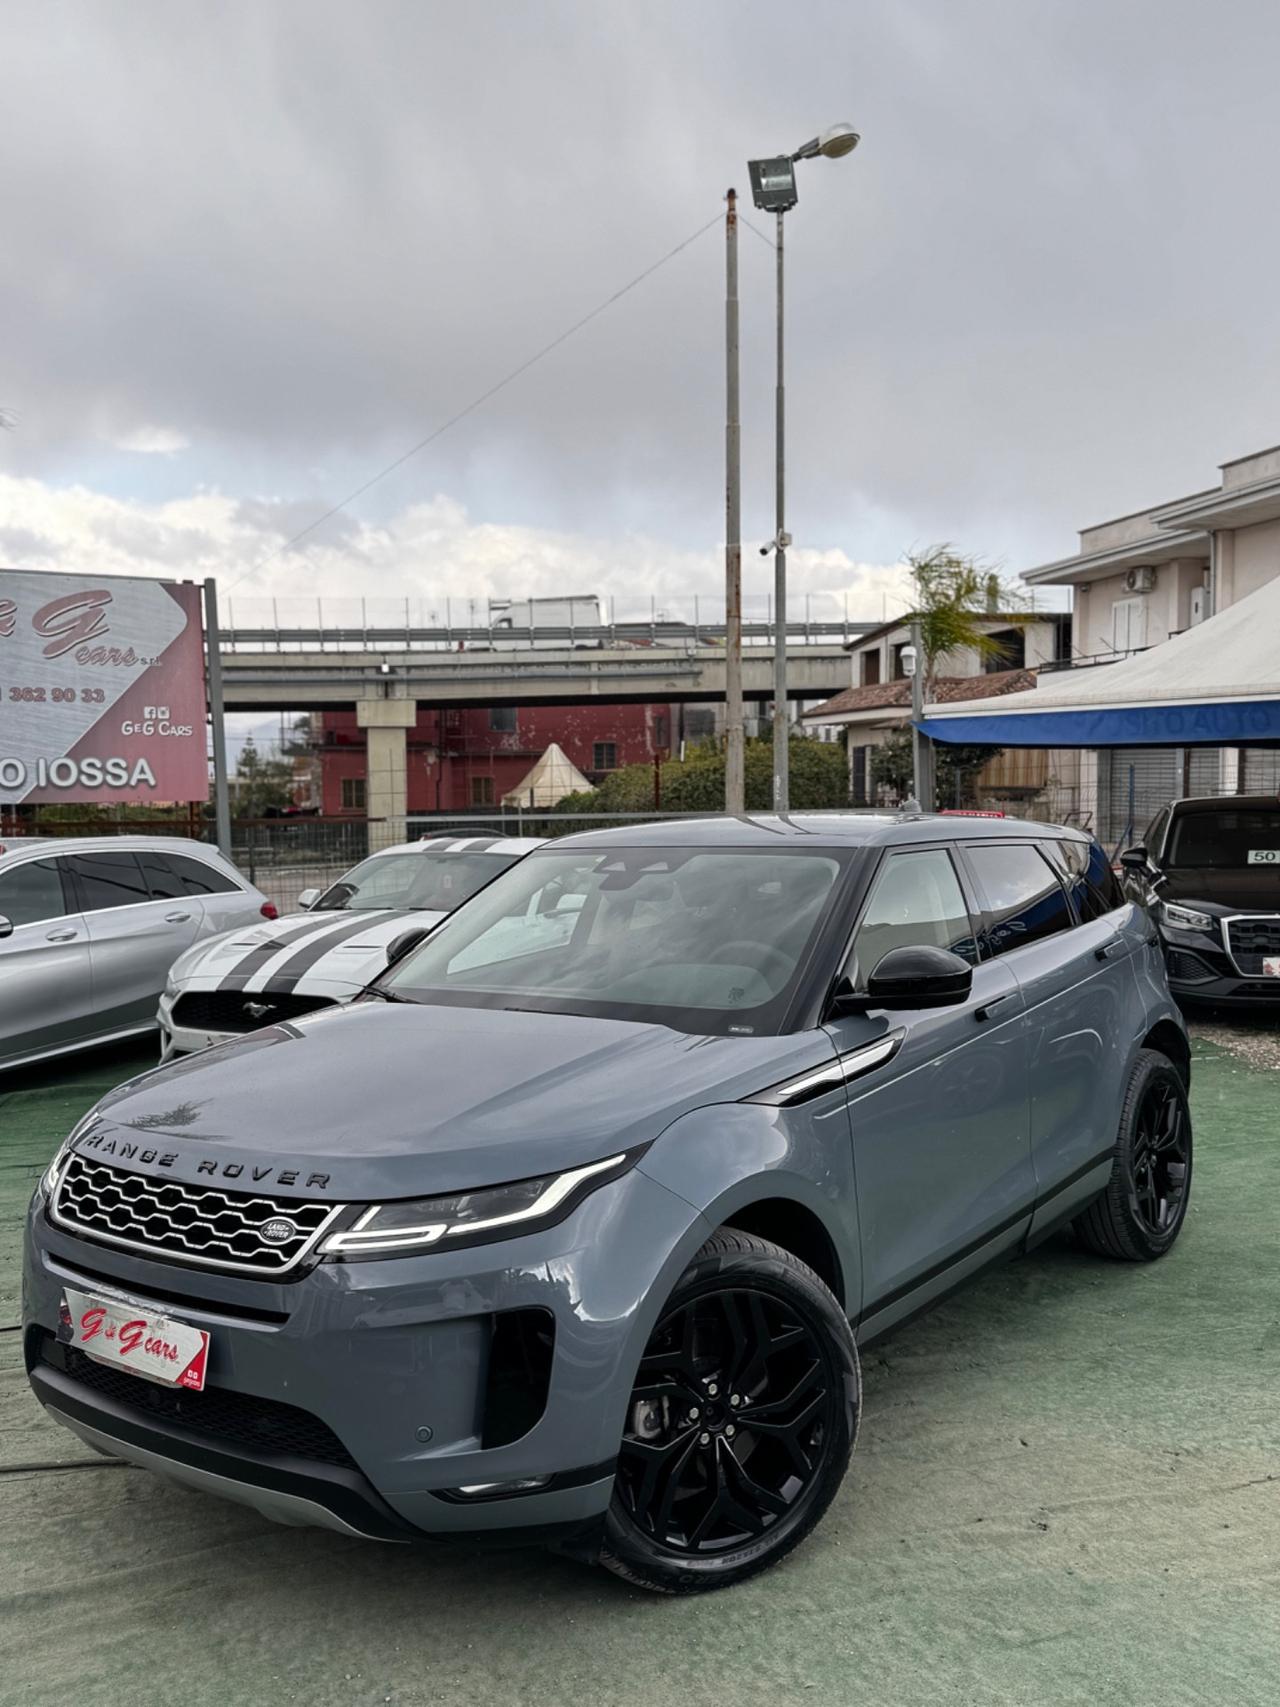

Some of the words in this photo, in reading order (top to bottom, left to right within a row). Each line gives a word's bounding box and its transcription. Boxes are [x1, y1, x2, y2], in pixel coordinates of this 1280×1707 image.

[9, 686, 47, 702] 362
[51, 687, 76, 703] 90
[81, 687, 105, 703] 33
[38, 757, 156, 788] IOSSA
[1254, 851, 1276, 862] 50
[86, 1135, 180, 1168] RANGE
[196, 1160, 331, 1190] ROVER
